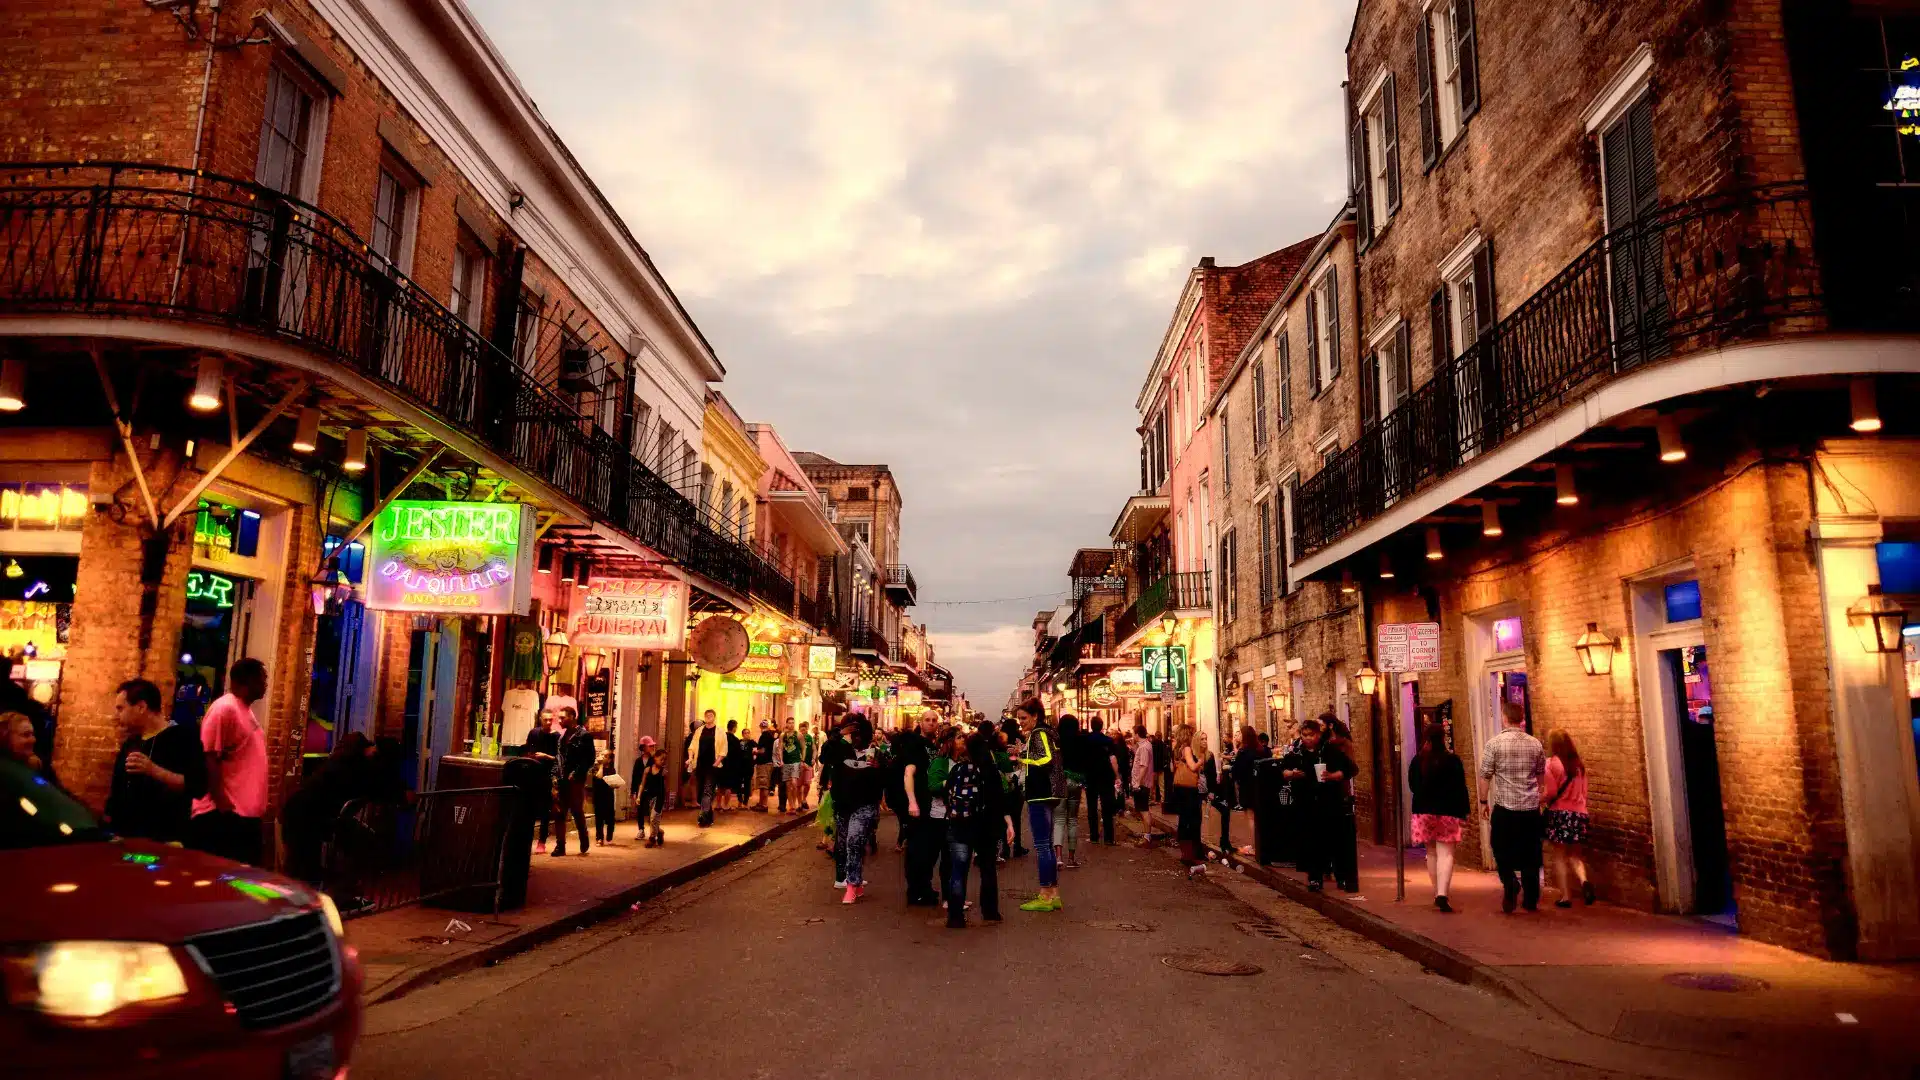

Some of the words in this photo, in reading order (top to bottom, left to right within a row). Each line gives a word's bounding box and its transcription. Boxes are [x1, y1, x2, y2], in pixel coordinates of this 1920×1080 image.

[381, 506, 518, 545] JESTER
[591, 580, 666, 598] JAZZ
[402, 592, 434, 605] AND
[439, 595, 477, 606] PIZZA
[1411, 661, 1438, 669] ANYTIME
